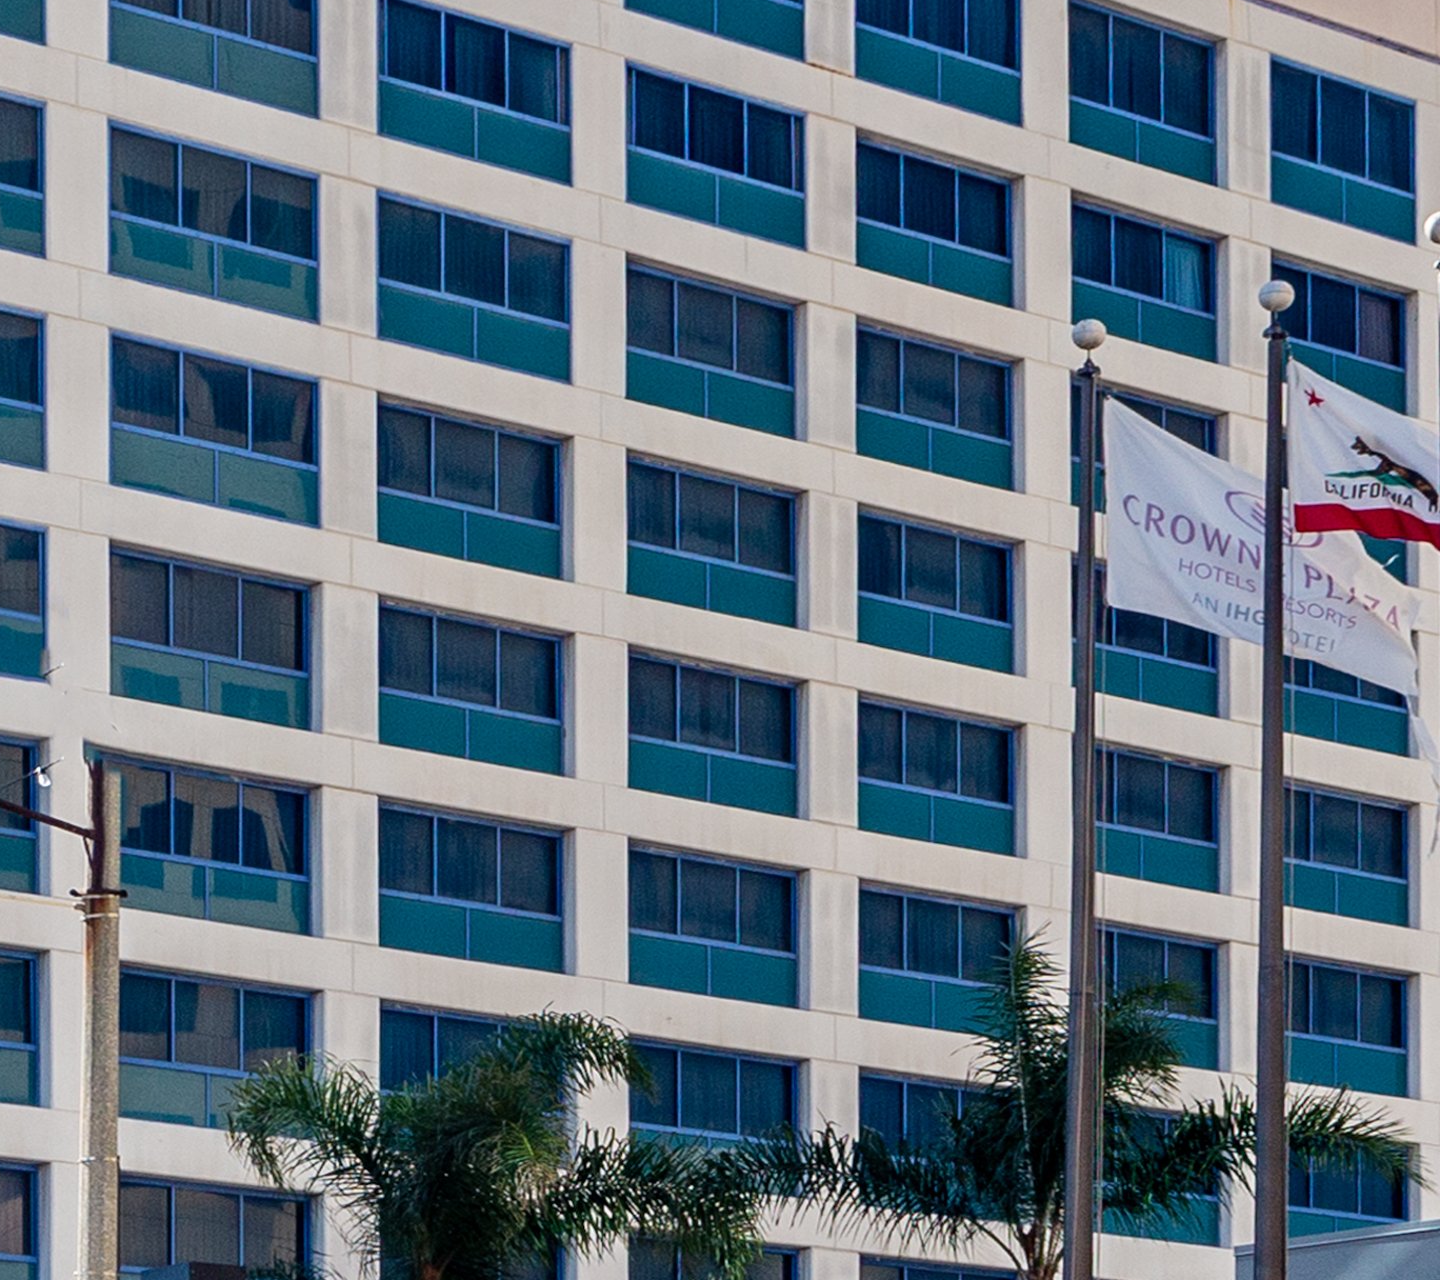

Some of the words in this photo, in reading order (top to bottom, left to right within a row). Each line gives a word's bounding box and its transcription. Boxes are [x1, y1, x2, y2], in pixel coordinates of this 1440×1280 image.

[1123, 494, 1283, 576] CROWN
[1178, 558, 1257, 593] HOTELS
[1282, 594, 1357, 629] ESORTS
[1192, 592, 1218, 614] AN
